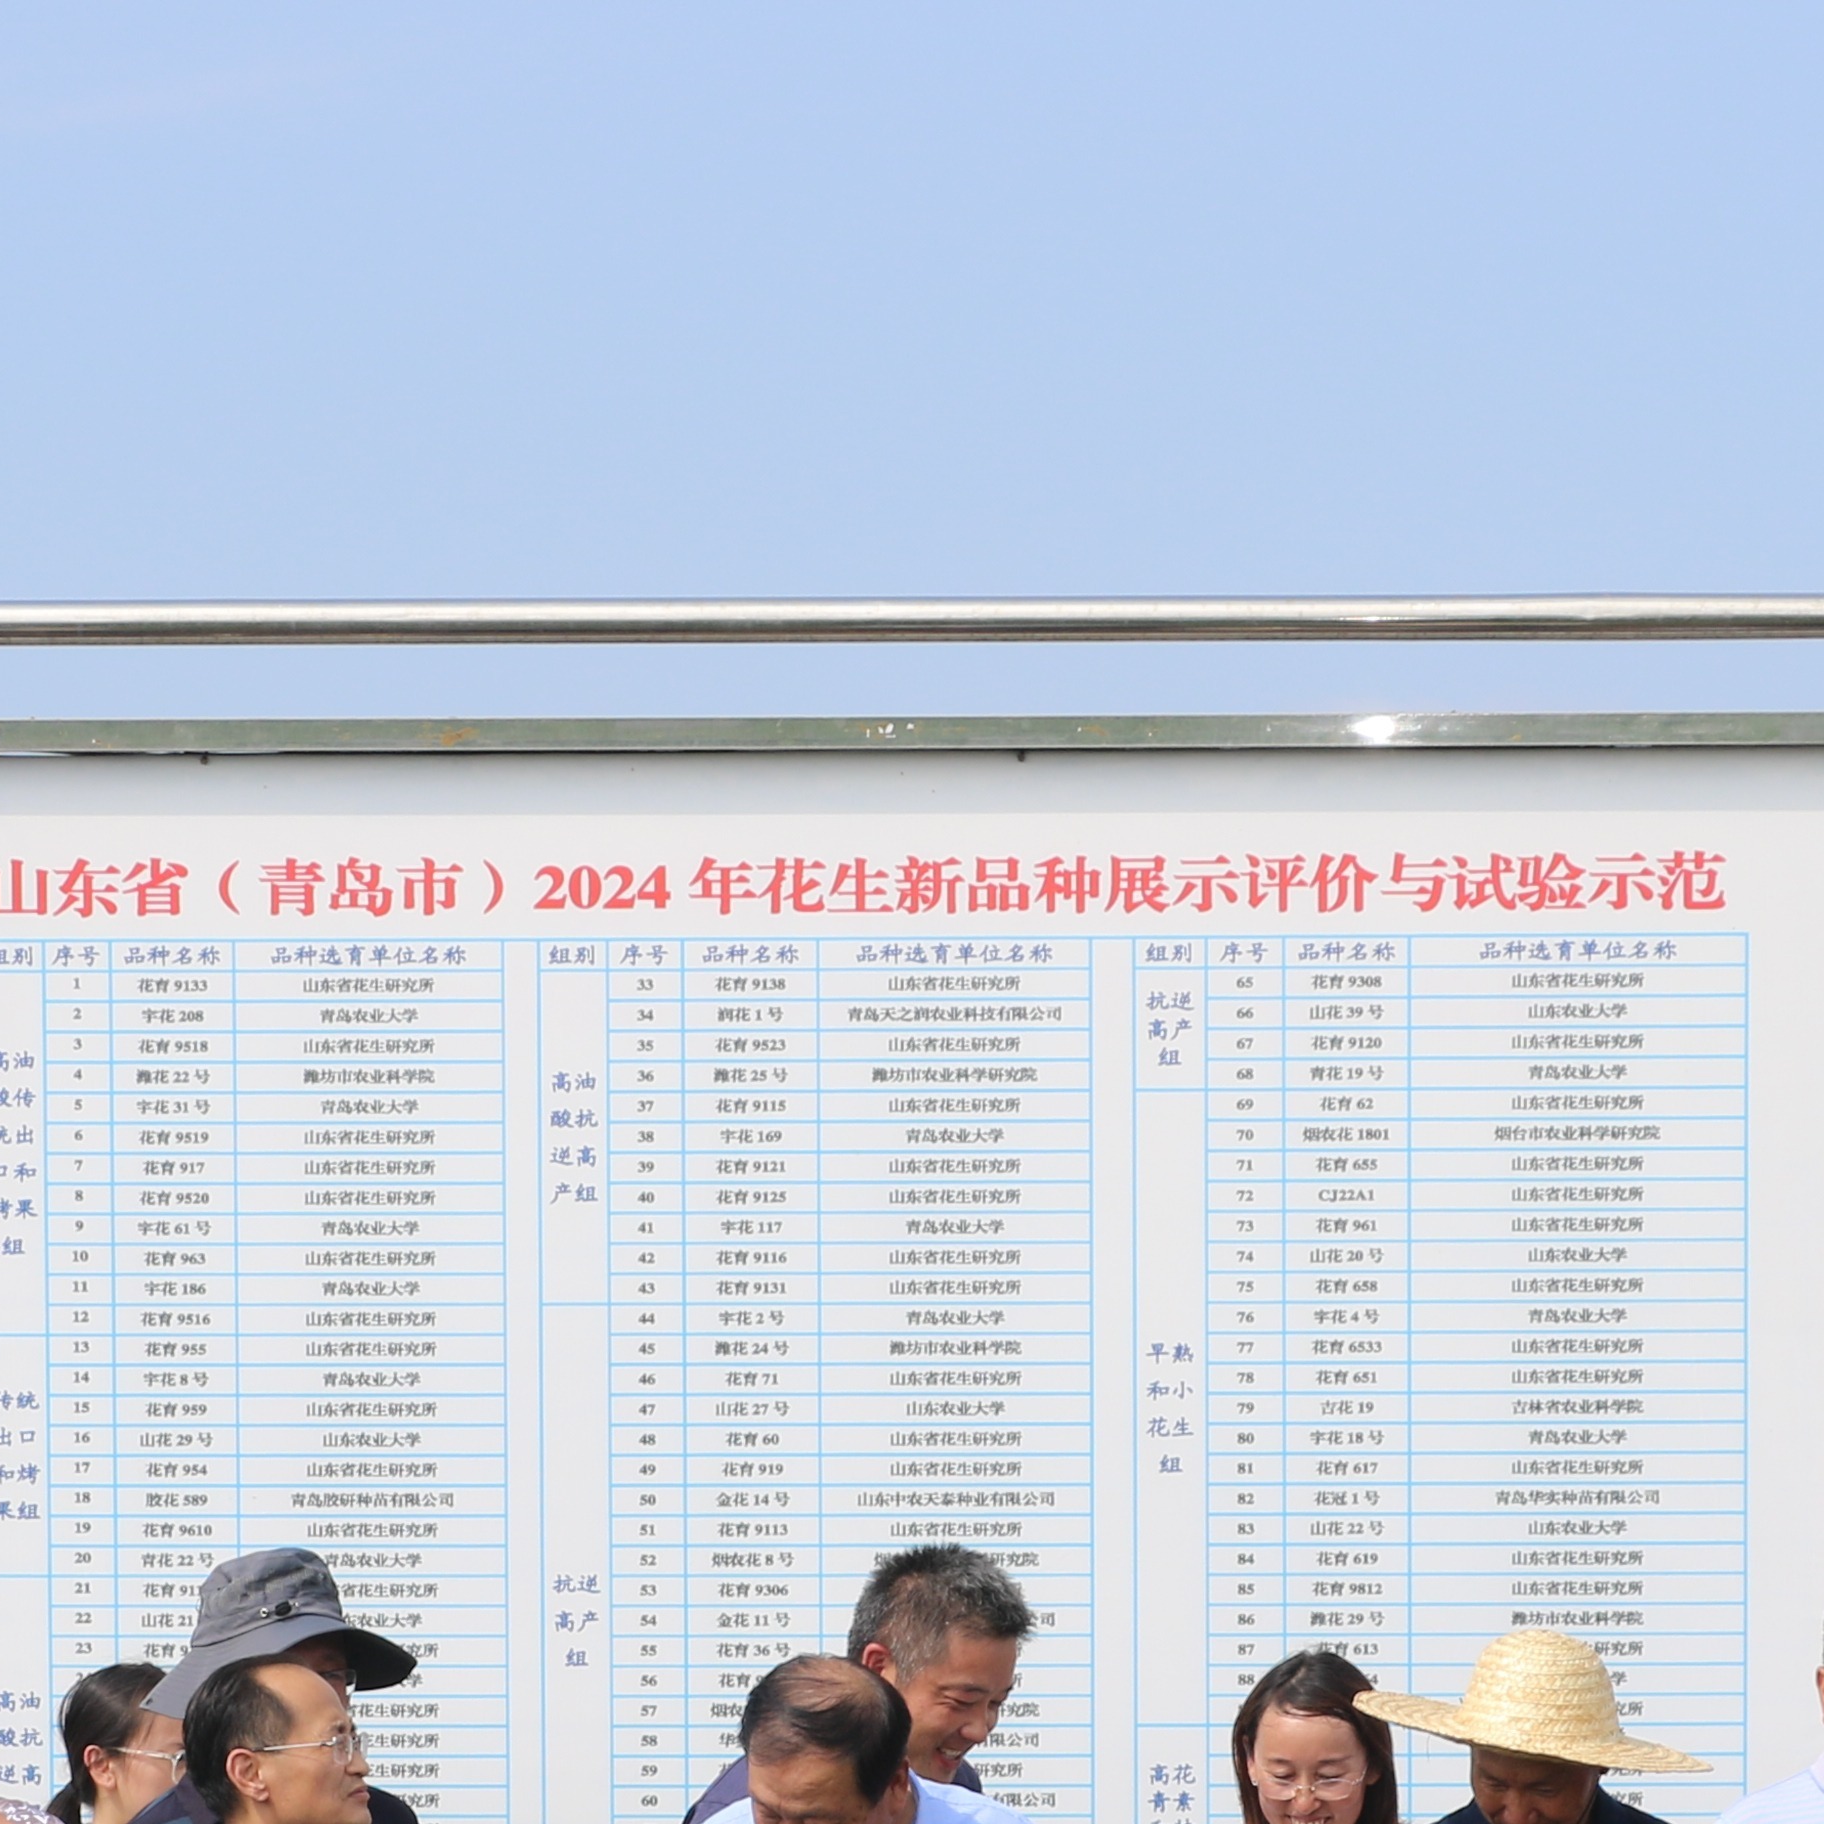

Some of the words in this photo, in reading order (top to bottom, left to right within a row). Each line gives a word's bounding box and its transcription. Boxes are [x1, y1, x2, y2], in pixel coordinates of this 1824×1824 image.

[52, 945, 100, 967] 序号
[124, 945, 220, 966] 品种名称
[271, 944, 466, 967] 品种选育单位名称
[549, 945, 595, 965] 组别
[620, 944, 668, 966] 序号
[702, 944, 799, 965] 品种名称
[856, 943, 1052, 965] 品种选育单位名称
[1145, 943, 1191, 963] 组别
[1220, 942, 1268, 963] 序号
[1298, 941, 1395, 962] 品种名称
[1479, 939, 1677, 961] 品种选育单位名称
[73, 977, 81, 990] 1
[636, 978, 654, 992] 33
[1235, 976, 1254, 989] 65
[636, 1008, 655, 1022] 34
[72, 1037, 83, 1051] 3
[72, 1068, 83, 1081] 4
[636, 1130, 655, 1144] 38
[1235, 1128, 1255, 1142] 70
[73, 1159, 84, 1172] 7
[1235, 1189, 1254, 1202] 72
[73, 1340, 90, 1354] 13
[637, 1372, 657, 1386] 46
[1236, 1401, 1256, 1415] 79
[74, 1491, 92, 1504] 18
[638, 1493, 657, 1507] 50
[1236, 1492, 1255, 1506] 82
[1237, 1582, 1255, 1596] 85
